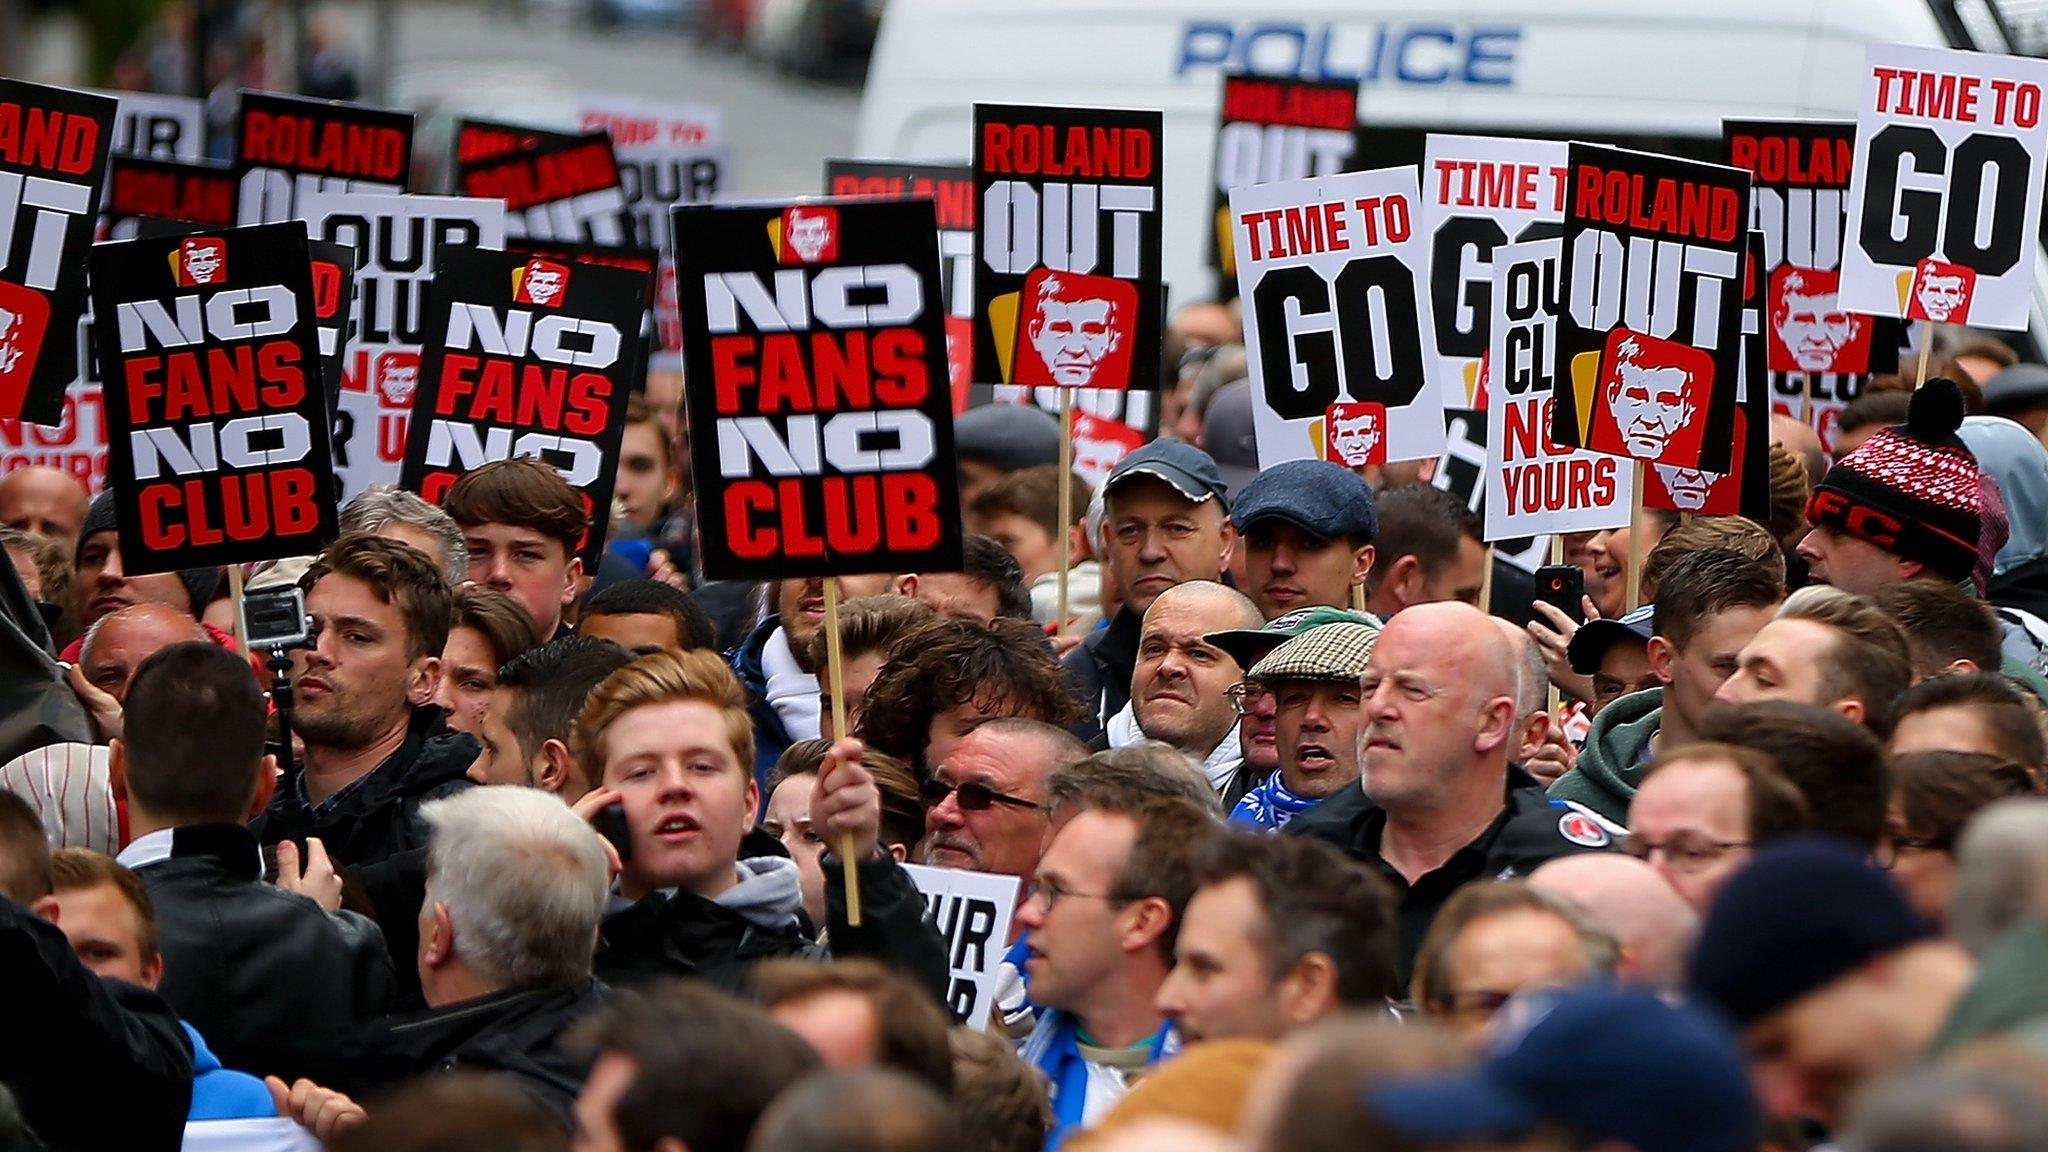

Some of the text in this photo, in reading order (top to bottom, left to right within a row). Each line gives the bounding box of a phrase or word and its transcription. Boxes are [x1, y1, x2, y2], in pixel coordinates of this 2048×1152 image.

[1178, 20, 1521, 86] POLICE
[1223, 80, 1357, 131] ROLAND
[1873, 67, 2042, 128] TIME TO
[243, 111, 406, 180] ROLAND
[983, 122, 1153, 179] ROLAND
[1434, 159, 1540, 210] TIME
[1575, 165, 1739, 242] ROLAND
[1859, 123, 2032, 278] GO
[983, 180, 1155, 278] OUT
[1240, 194, 1411, 261] TIME TO
[117, 284, 299, 352] NO
[704, 263, 926, 333] NO
[1569, 227, 1739, 350] OUT
[445, 302, 622, 369] NO
[1252, 254, 1426, 421] GO
[125, 340, 306, 424] FANS
[435, 354, 613, 437] FANS
[711, 327, 929, 414] FANS
[130, 412, 312, 480] NO
[425, 418, 603, 488] NO
[717, 409, 937, 478] NO
[139, 467, 320, 550] CLUB
[723, 471, 942, 559] CLUB
[1502, 457, 1617, 516] YOURS
